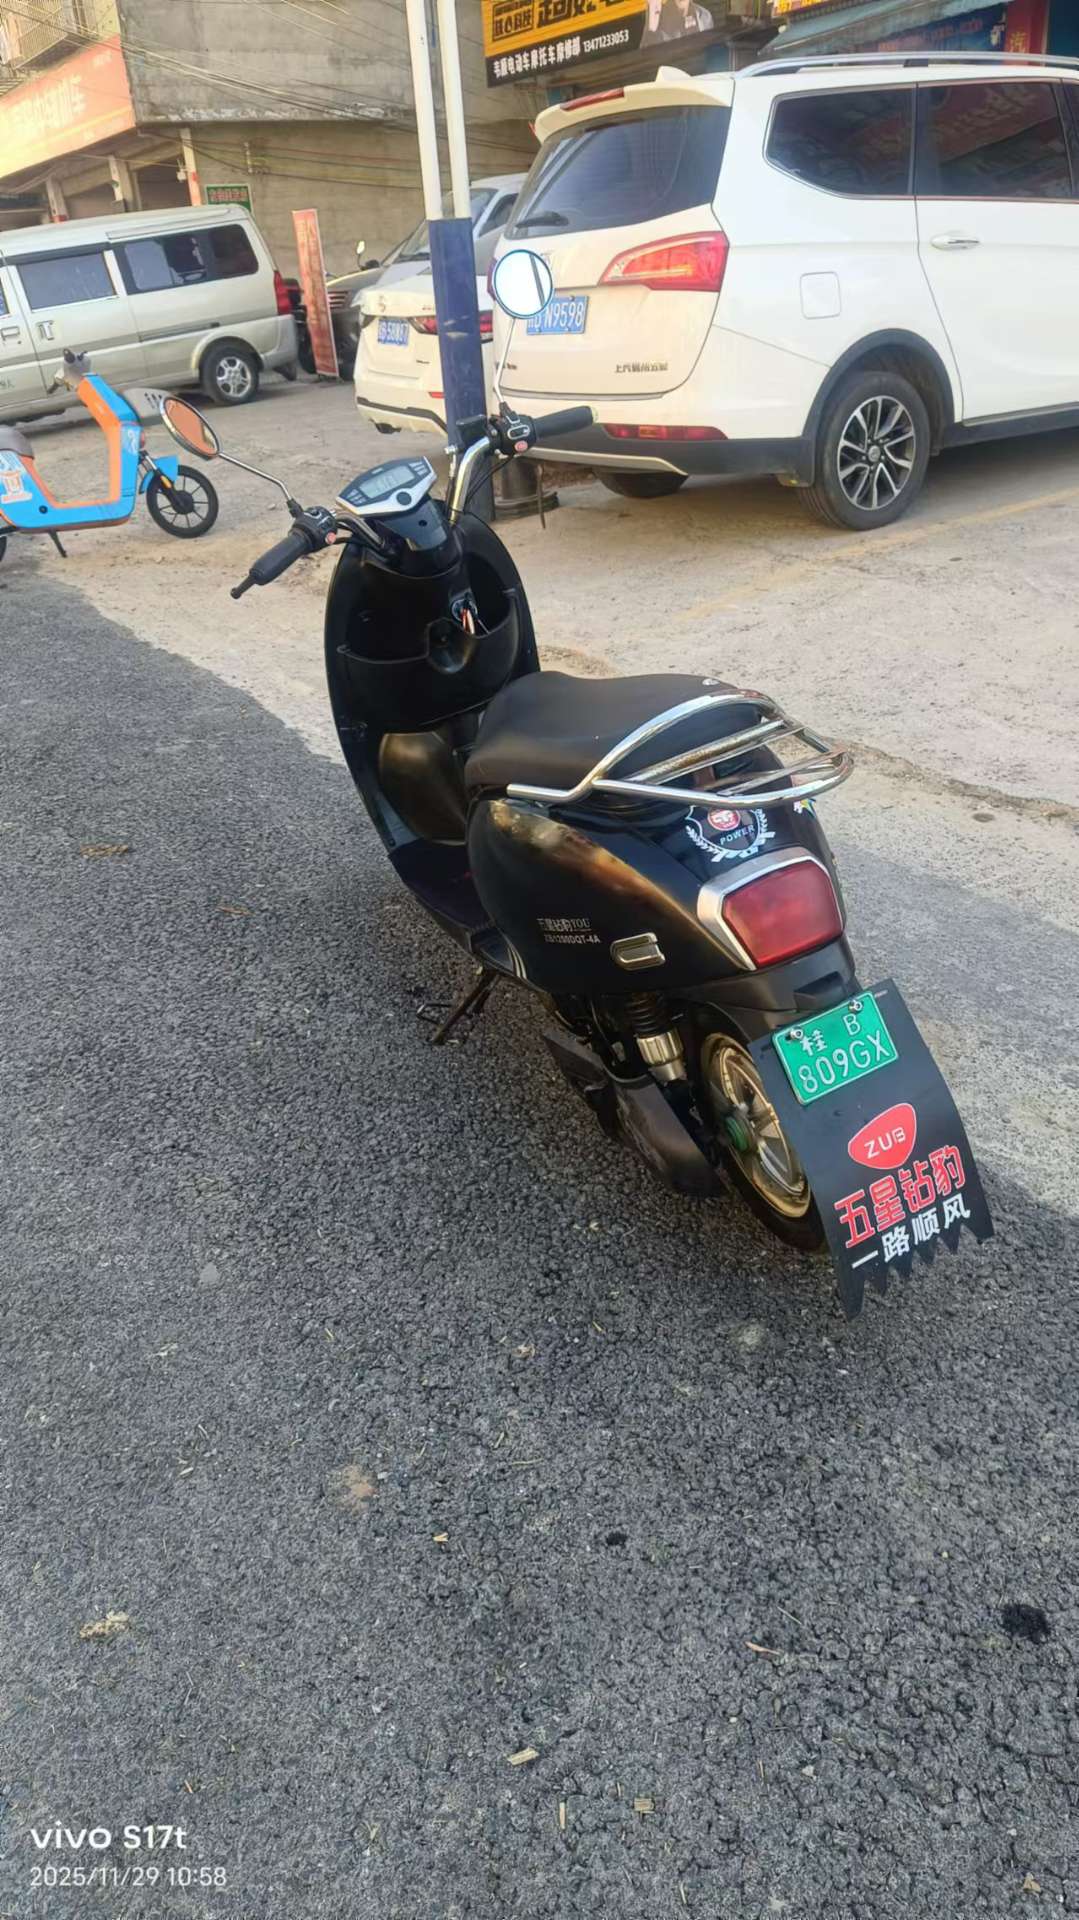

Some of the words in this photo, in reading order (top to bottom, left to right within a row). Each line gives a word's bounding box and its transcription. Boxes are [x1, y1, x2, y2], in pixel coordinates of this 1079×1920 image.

[720, 824, 755, 845] POWER
[799, 1029, 891, 1094] 809GX
[801, 1029, 828, 1056] 桂
[843, 1013, 861, 1036] B
[863, 1126, 907, 1159] ZUB
[834, 1145, 966, 1249] 五星钻豹
[851, 1192, 970, 1270] 一路顺风
